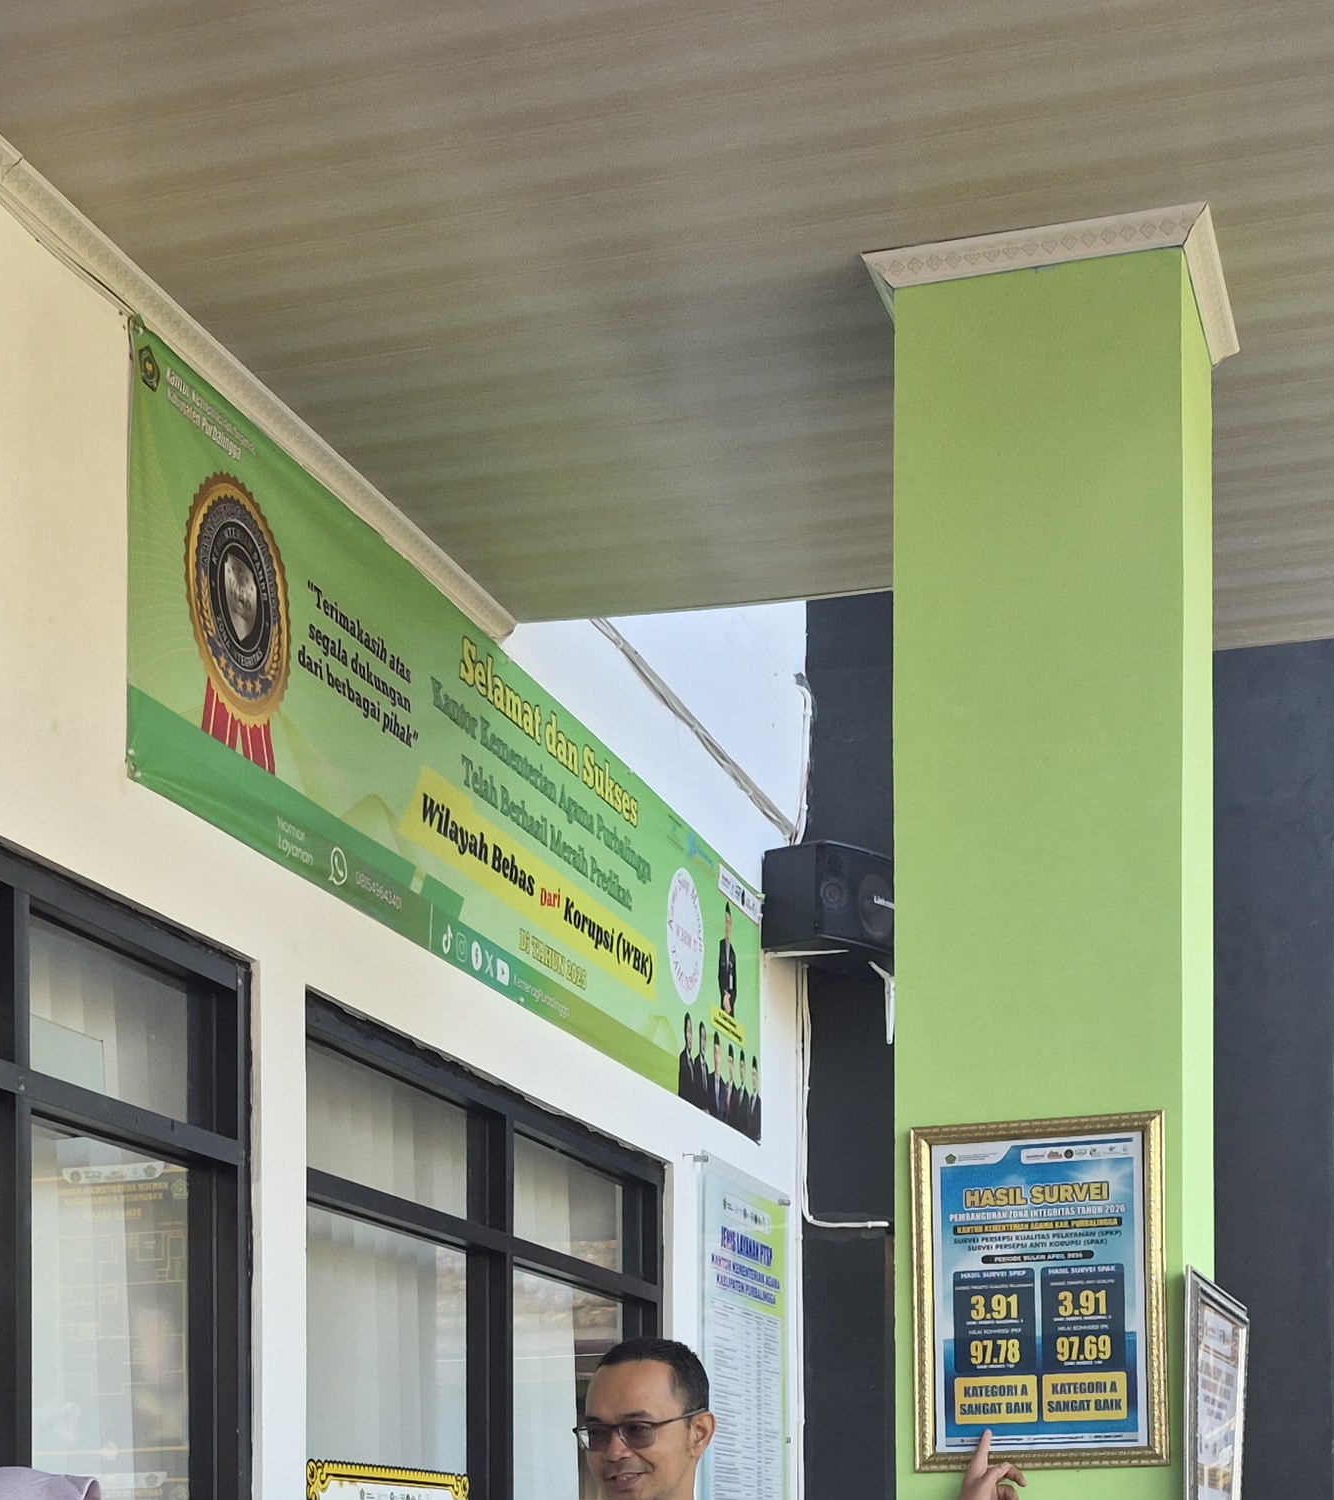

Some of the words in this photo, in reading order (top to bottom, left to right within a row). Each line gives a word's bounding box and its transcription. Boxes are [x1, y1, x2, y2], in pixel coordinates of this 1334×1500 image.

[297, 643, 324, 682] dari
[326, 662, 381, 719] berbagai
[308, 622, 349, 668] segala
[351, 651, 412, 715] dukungan
[389, 652, 412, 685] atas
[458, 635, 543, 747] Selamat
[544, 710, 580, 778] dan
[581, 744, 640, 829] Sukses
[430, 675, 478, 741] Kantor
[479, 715, 558, 804] Kementerian
[558, 783, 595, 830] Agama
[595, 812, 653, 885] Purbalingga
[461, 753, 499, 810] Telah
[500, 784, 548, 846] Berhasil
[549, 823, 589, 879] Meraih
[277, 835, 315, 868] Layanan
[422, 792, 489, 866] Wilayah
[491, 842, 536, 897] Bebas
[539, 887, 562, 909] Dari
[563, 897, 615, 954] Korupsi
[616, 931, 654, 986] (WBK)
[531, 934, 566, 979] TAHUN
[964, 1187, 1027, 1209] HASIL
[1030, 1181, 1109, 1204] SURVEI
[949, 1211, 1008, 1222] PEMBANGUNAN
[1008, 1209, 1029, 1219] ZONA
[1030, 1208, 1076, 1218] INTEGRITAS
[1077, 1205, 1104, 1215] TAHUN
[736, 1232, 760, 1263] LAYANAN
[953, 1237, 979, 1245] SURVEI
[981, 1235, 1014, 1243] PERSEPSI
[1015, 1233, 1051, 1242] KUALITAS
[1052, 1231, 1096, 1240] PELAYANAN
[967, 1244, 994, 1252] SURVEI
[995, 1242, 1028, 1251] PERSEPSI
[1029, 1241, 1047, 1249] ANTI
[1049, 1239, 1082, 1248] KORUPSI
[970, 1293, 1018, 1321] 3.91
[1058, 1289, 1107, 1317] 3.91
[970, 1338, 1020, 1365] 97.78
[1056, 1335, 1112, 1362] 97.69
[963, 1384, 1018, 1398] KATEGORI
[1020, 1384, 1028, 1396] A
[1051, 1381, 1107, 1395] KATEGORI
[1109, 1381, 1117, 1393] A
[959, 1402, 1003, 1416] SANGAT
[1005, 1402, 1033, 1414] BAIK
[1047, 1399, 1091, 1413] SANGAT
[1094, 1398, 1122, 1412] BAIK
